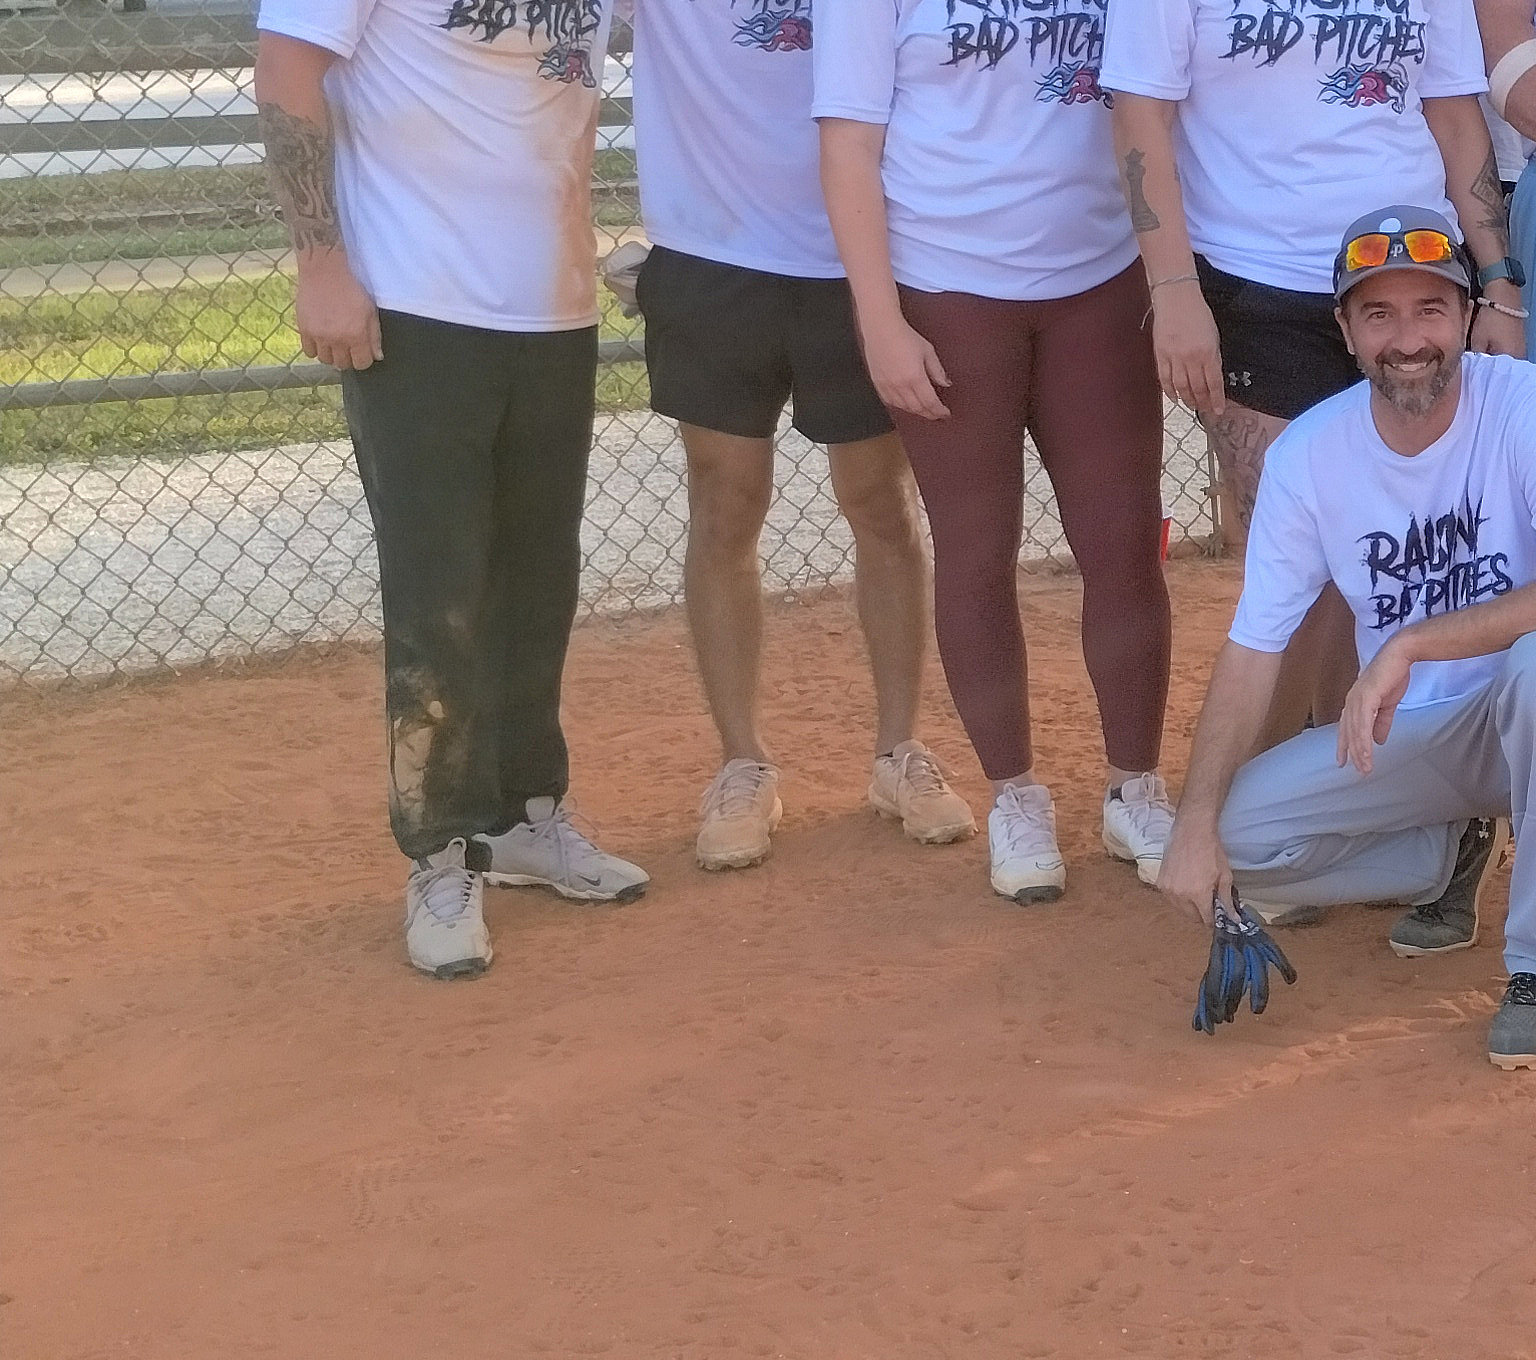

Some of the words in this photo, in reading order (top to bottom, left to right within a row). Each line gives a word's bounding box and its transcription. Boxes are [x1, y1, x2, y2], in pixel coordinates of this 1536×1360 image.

[939, 13, 1019, 71] BAD
[1020, 13, 1108, 68] PITCH
[1218, 5, 1304, 68] BAD
